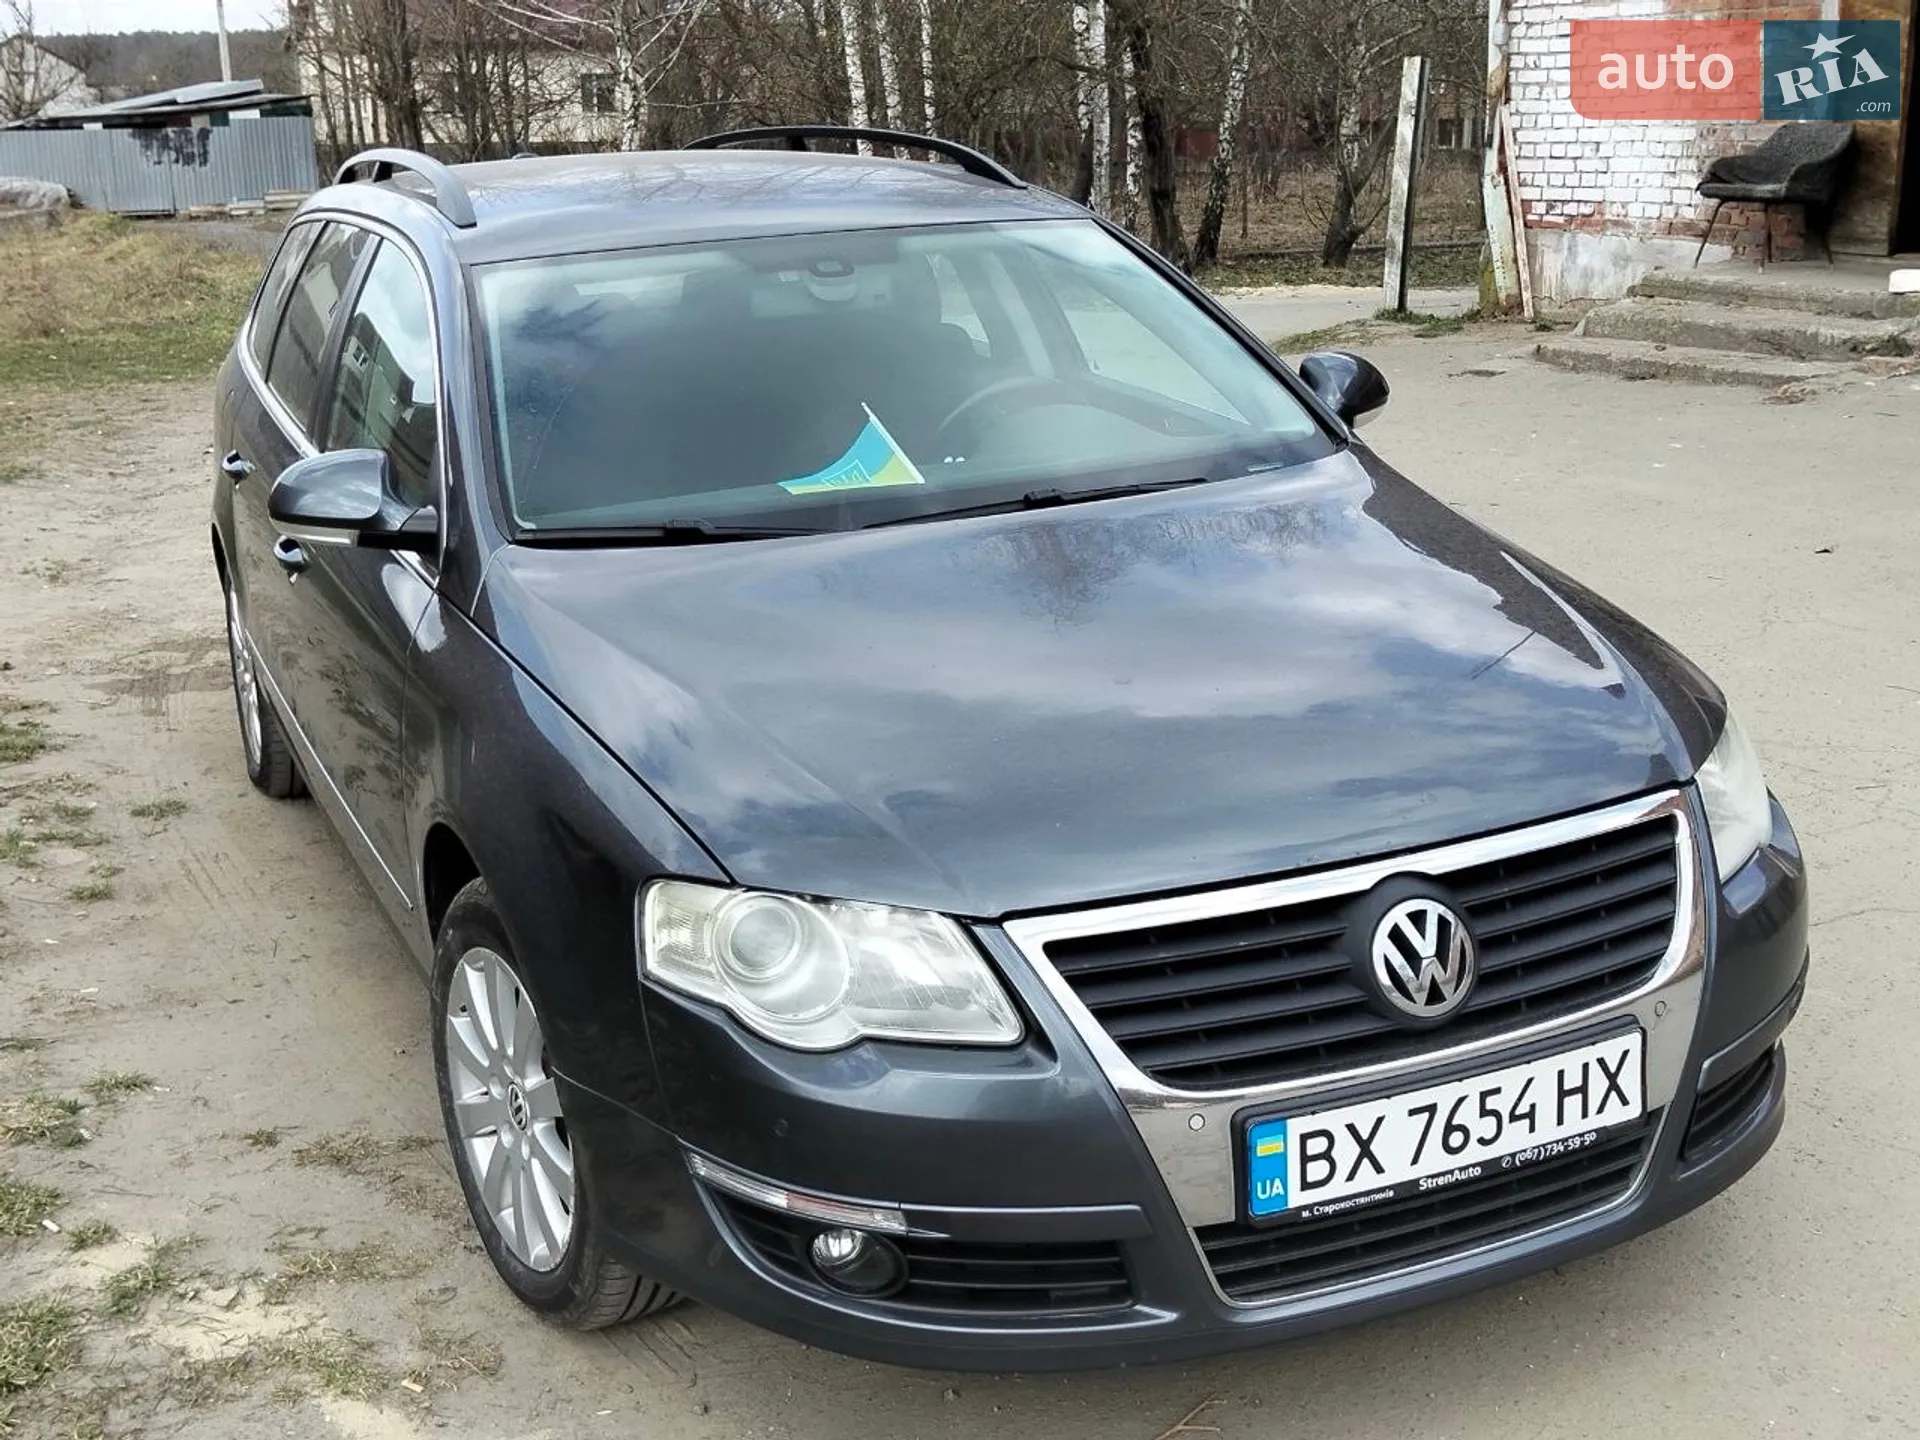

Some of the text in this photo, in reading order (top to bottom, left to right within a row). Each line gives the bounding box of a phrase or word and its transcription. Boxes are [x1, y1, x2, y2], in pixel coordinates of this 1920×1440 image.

[1299, 1049, 1631, 1192] BX 7654 HX
[1256, 1177, 1285, 1200] UA
[1418, 1165, 1482, 1191] StrenAuto
